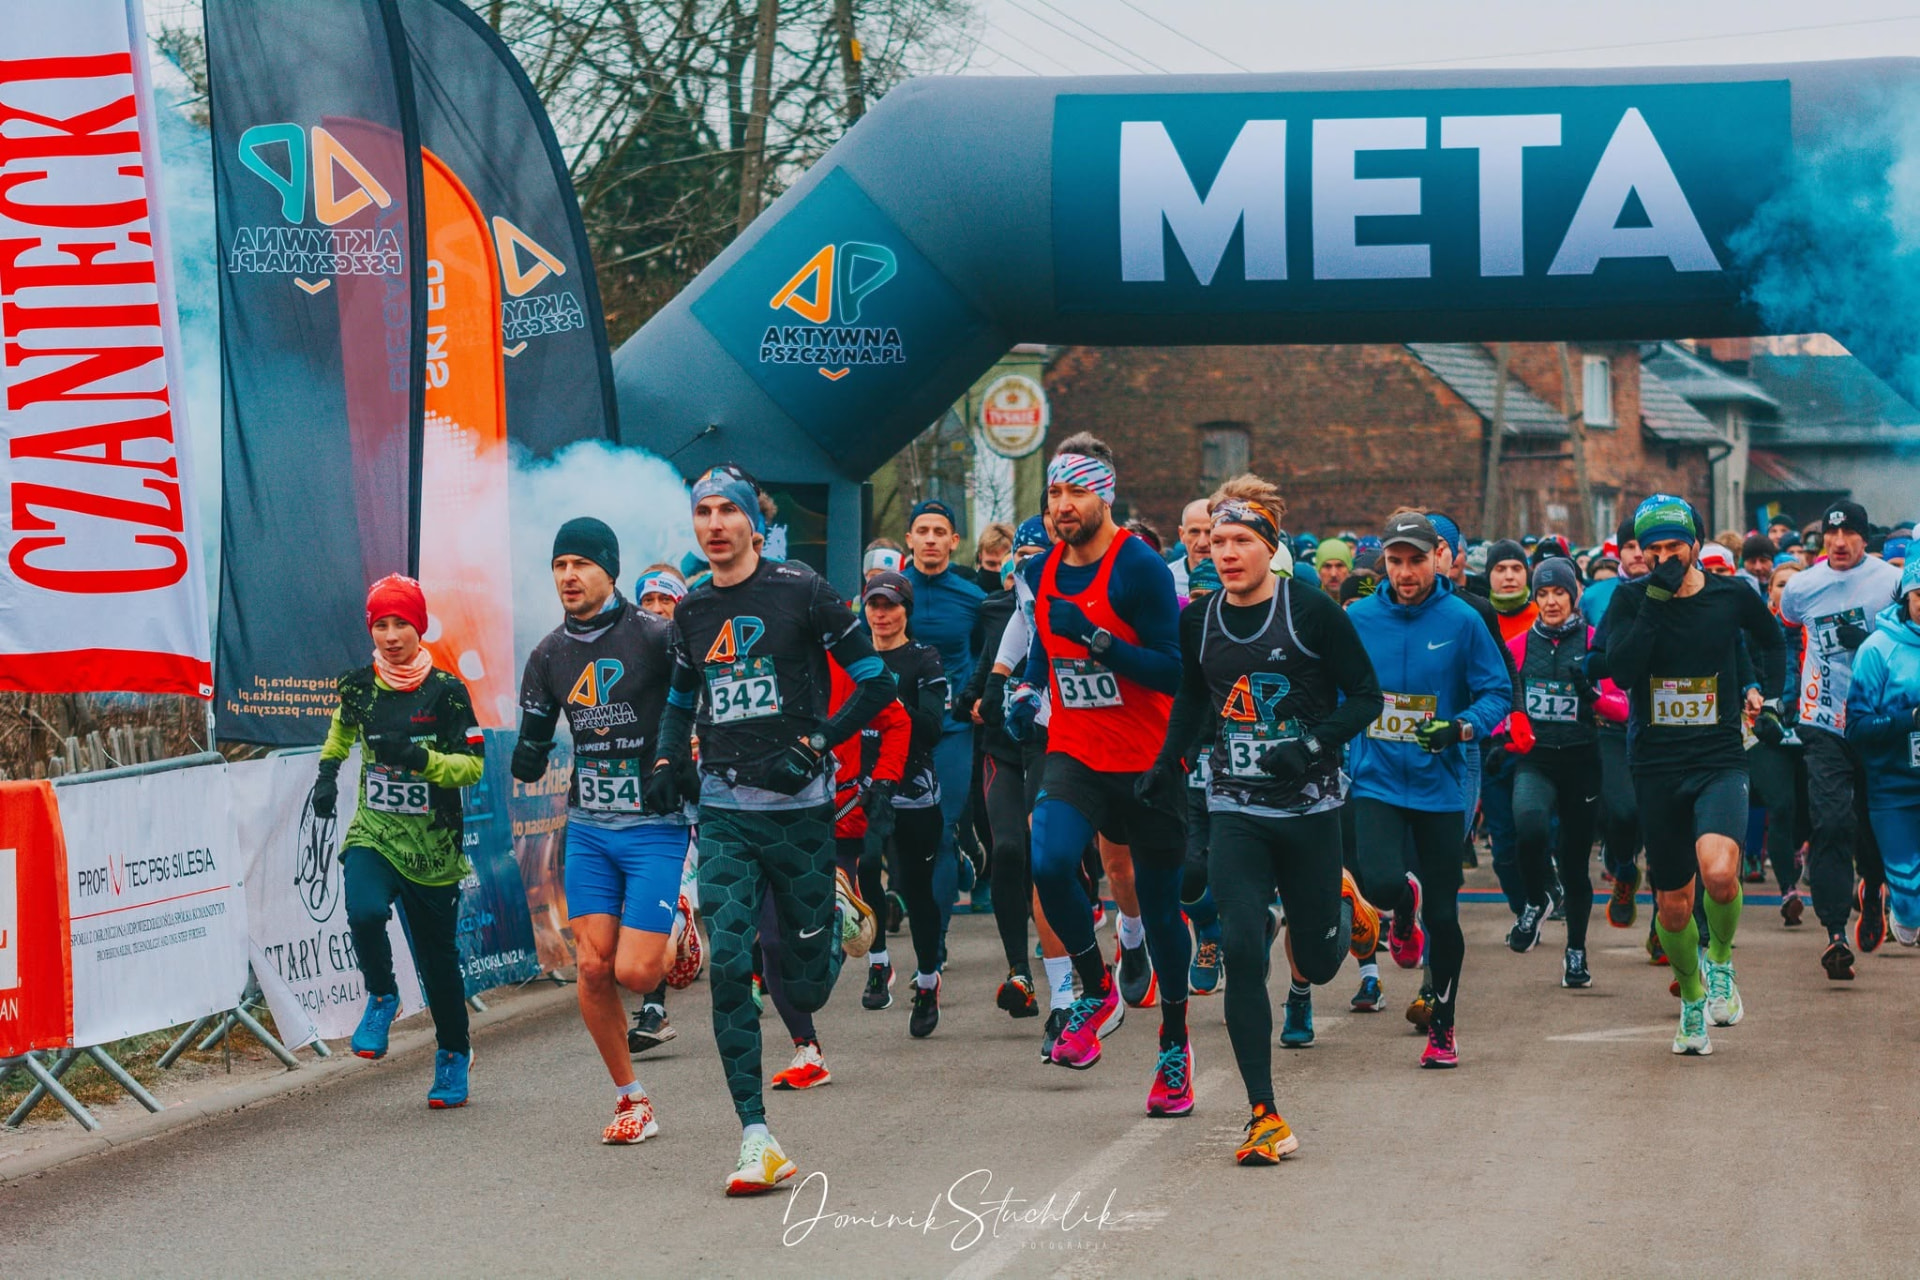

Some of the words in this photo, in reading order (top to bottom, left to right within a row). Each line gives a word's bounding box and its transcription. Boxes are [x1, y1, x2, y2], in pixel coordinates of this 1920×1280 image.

[1119, 107, 1722, 286] META
[0, 52, 188, 594] CZANIECKI
[761, 326, 902, 348] AKTYWNA
[760, 345, 906, 364] PSZCZYNA.PL
[715, 680, 775, 715] 342
[1062, 675, 1117, 700] 310
[571, 702, 634, 721] AKTYWNA
[1528, 694, 1575, 716] 212
[1657, 701, 1714, 718] 1037
[1374, 714, 1425, 734] 102
[616, 737, 644, 749] TEAM
[370, 781, 427, 807] 258
[581, 777, 638, 804] 354
[77, 866, 109, 898] PROFI
[125, 860, 149, 889] TEC
[149, 856, 170, 884] PSG
[171, 848, 216, 879] SILESIA
[331, 980, 361, 1006] SALA
